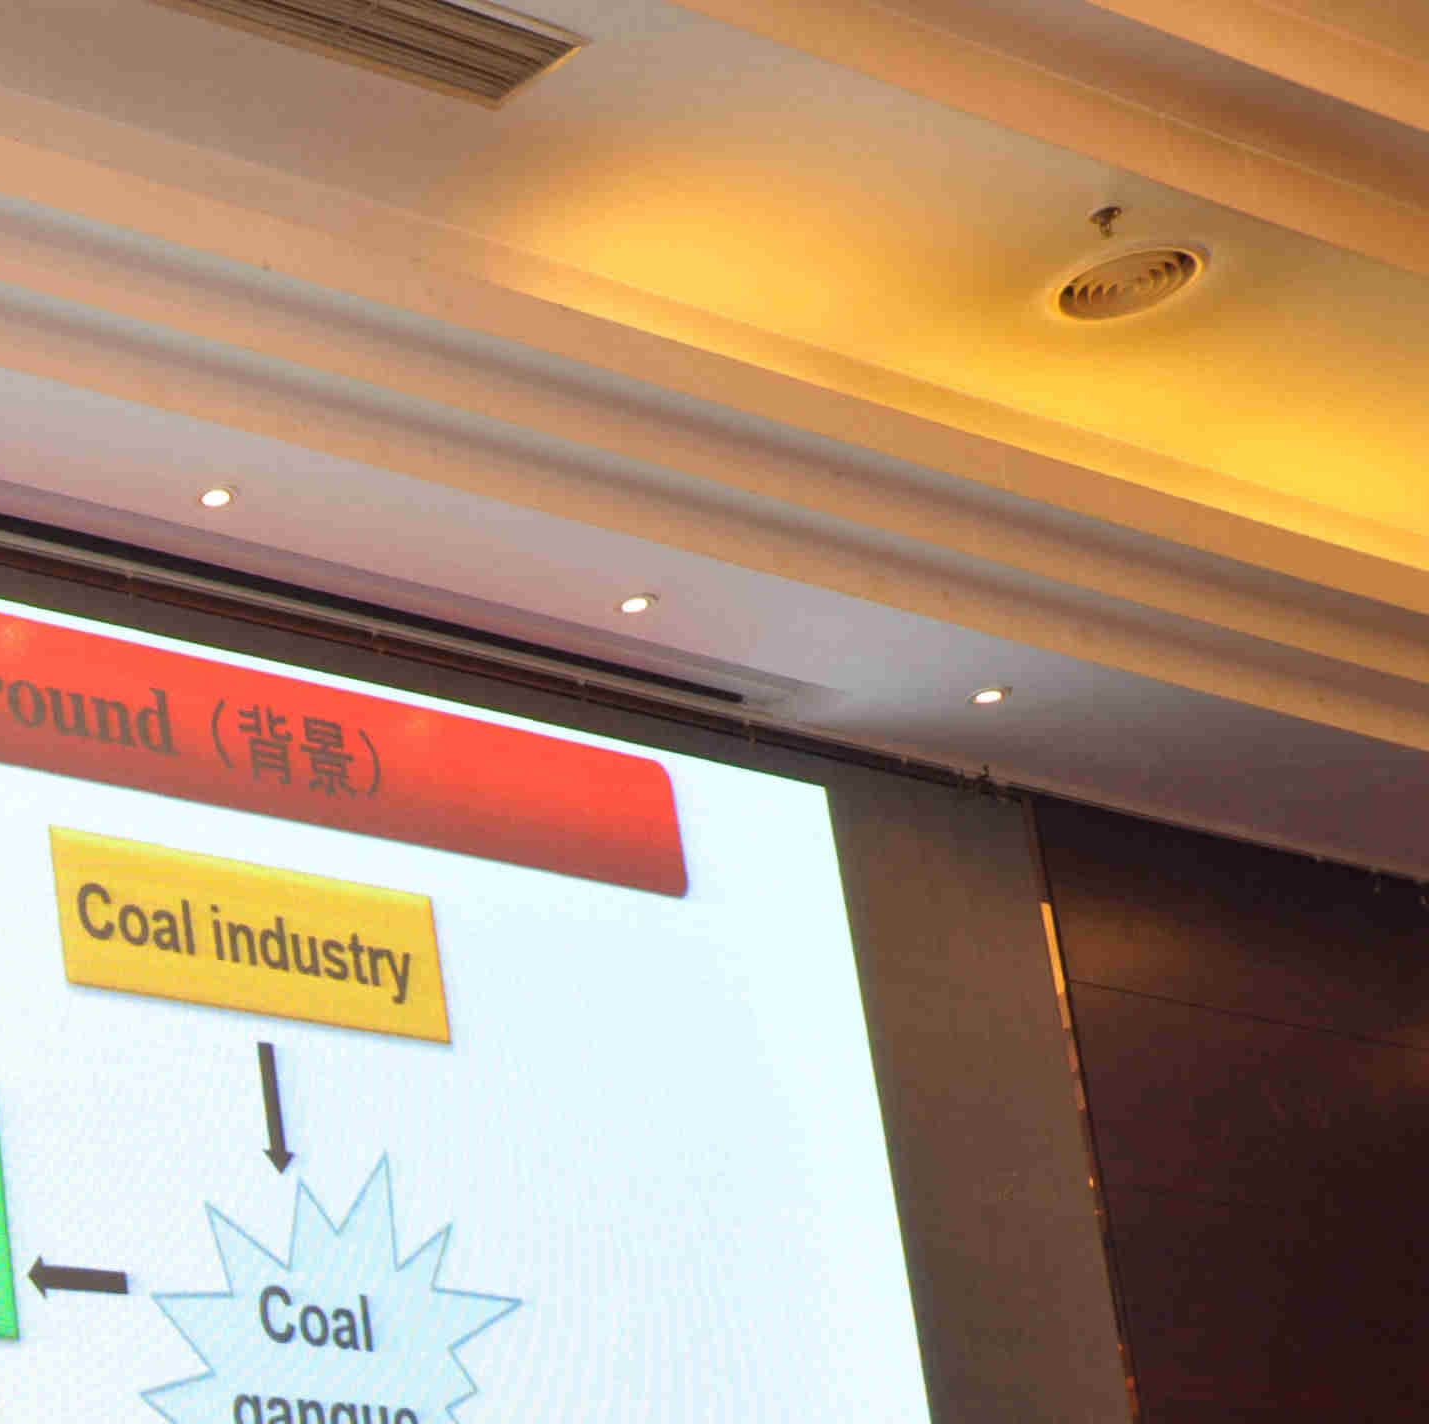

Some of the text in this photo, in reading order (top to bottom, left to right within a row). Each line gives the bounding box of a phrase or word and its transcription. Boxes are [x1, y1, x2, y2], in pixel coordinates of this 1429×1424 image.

[78, 883, 413, 1003] Coal industry
[259, 1286, 374, 1352] Coal
